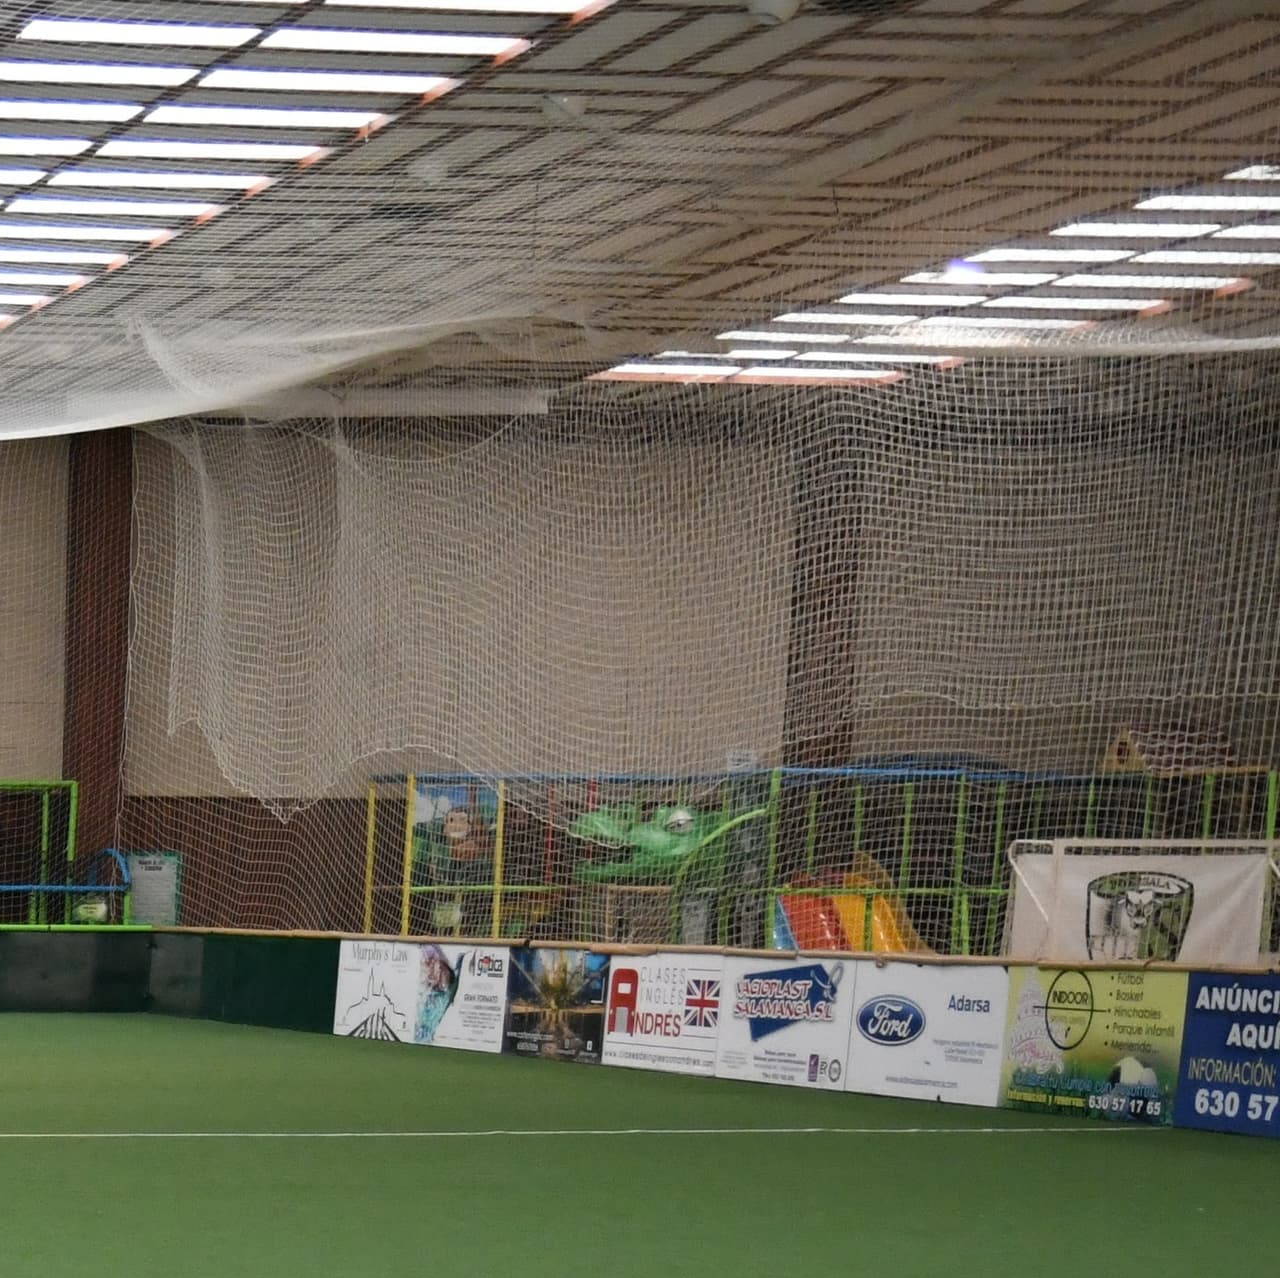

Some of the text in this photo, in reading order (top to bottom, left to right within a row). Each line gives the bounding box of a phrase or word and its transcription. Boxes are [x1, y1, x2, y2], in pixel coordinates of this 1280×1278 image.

[352, 943, 408, 966] Murphy's Law
[640, 967, 686, 984] CLASES
[948, 995, 990, 1012] Adarsa
[1052, 990, 1089, 1004] INDOOR
[1115, 990, 1144, 1001] Basket
[868, 1002, 913, 1038] Ford
[1112, 1022, 1141, 1036] Parque
[1188, 1057, 1277, 1088] INFORMACIÓN:
[1089, 1095, 1109, 1110] 630
[1111, 1098, 1126, 1111] 57
[1130, 1100, 1143, 1113] 17
[1146, 1102, 1161, 1115] 65
[1195, 1088, 1280, 1121] 630 57
